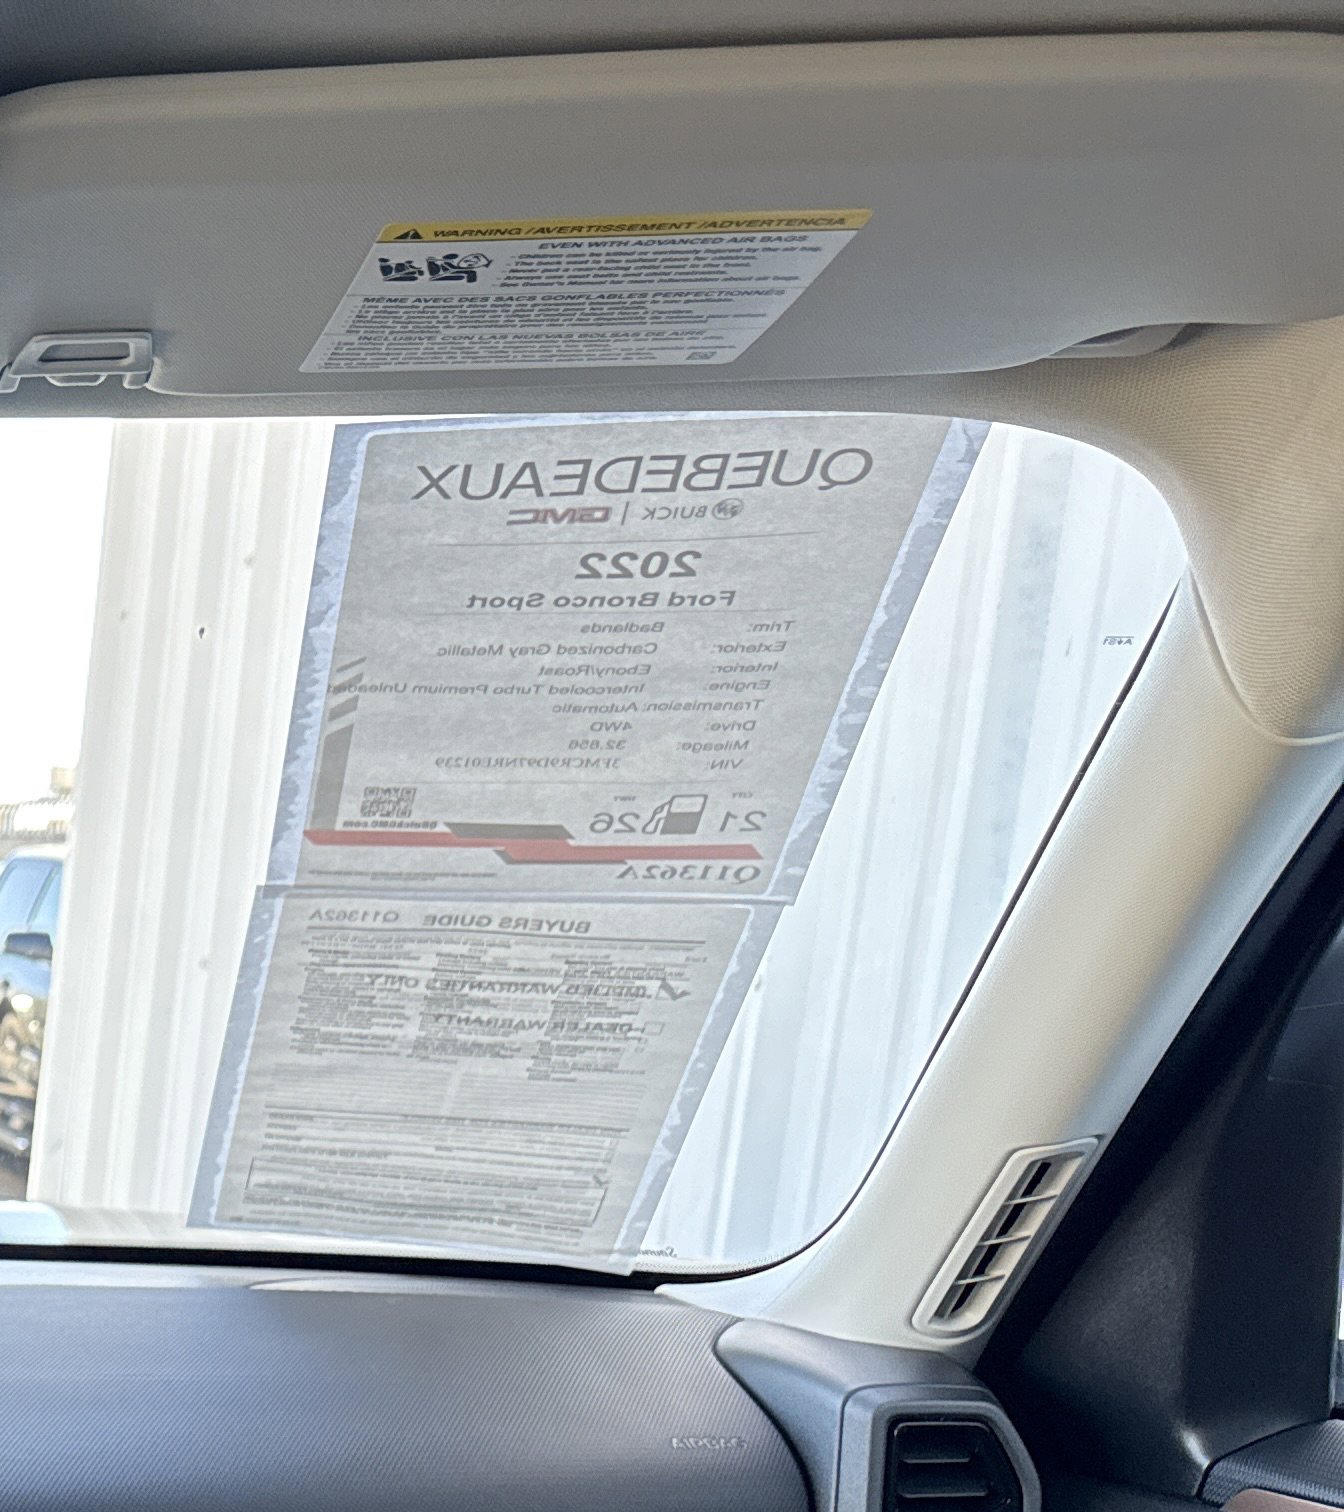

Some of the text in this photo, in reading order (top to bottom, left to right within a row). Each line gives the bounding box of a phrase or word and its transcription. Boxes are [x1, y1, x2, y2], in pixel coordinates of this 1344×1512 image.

[433, 228, 522, 238] WARNING
[538, 235, 809, 250] EVEN WITH ADVANCED AIR BAGS
